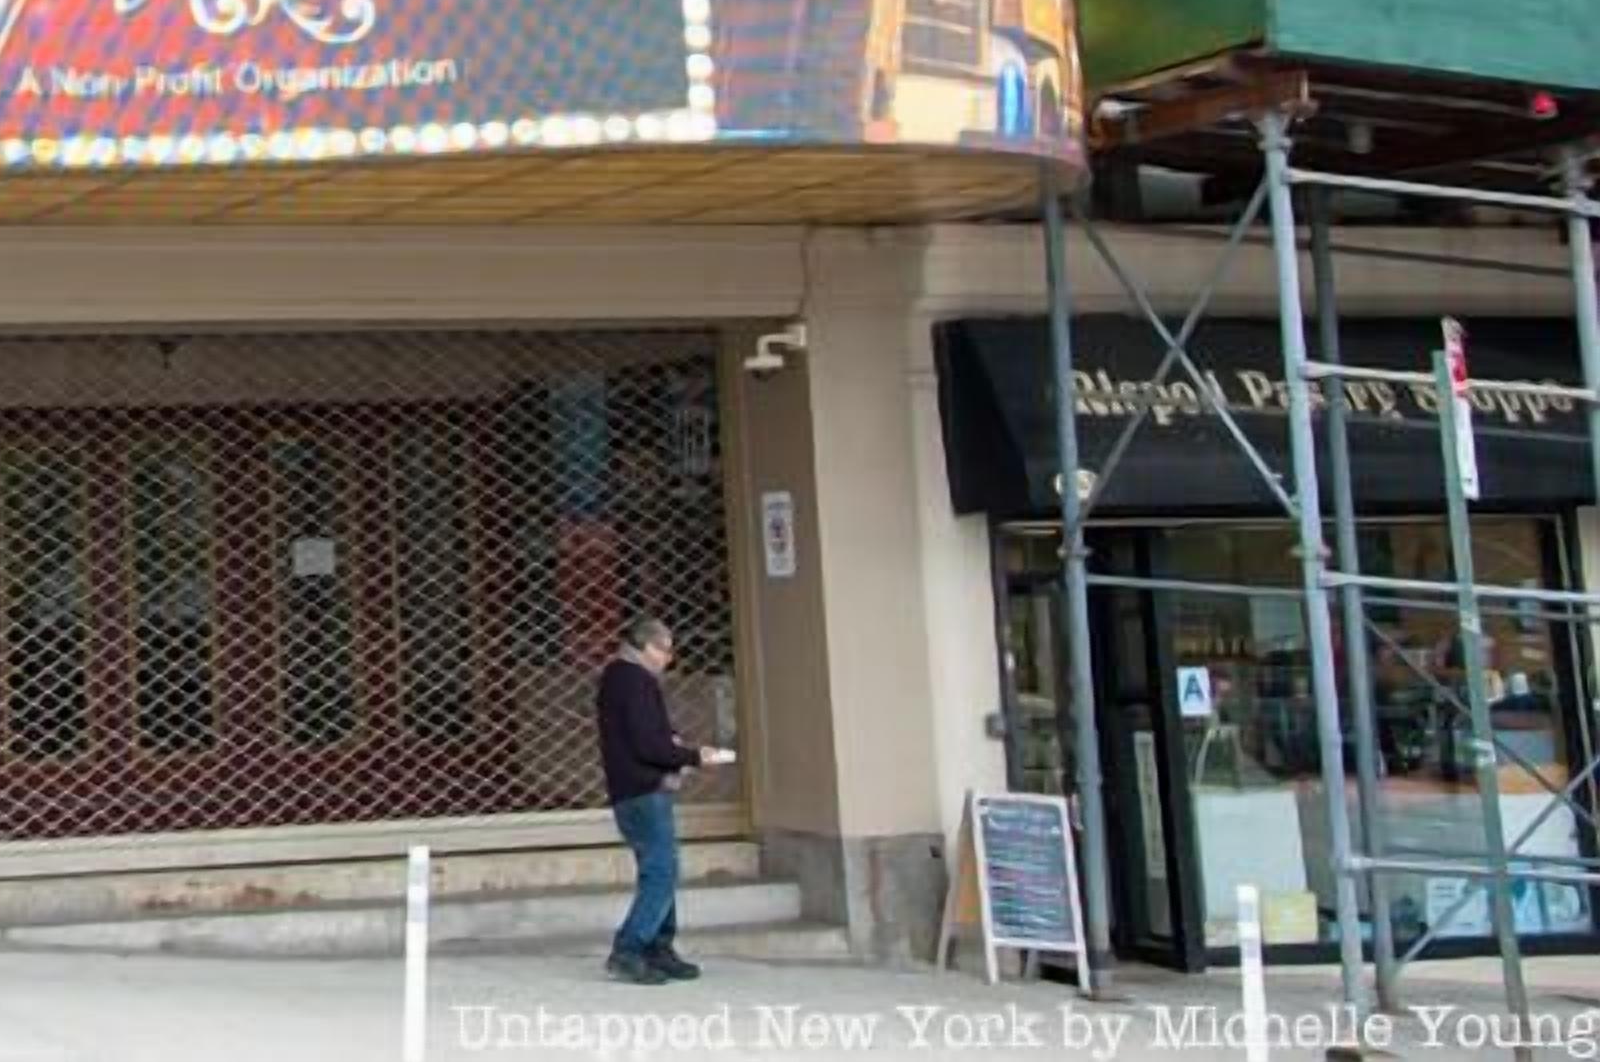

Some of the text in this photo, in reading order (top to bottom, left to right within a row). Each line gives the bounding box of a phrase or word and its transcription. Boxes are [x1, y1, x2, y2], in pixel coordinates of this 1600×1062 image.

[14, 65, 42, 96] A
[234, 57, 459, 101] Organization
[1183, 673, 1206, 702] A
